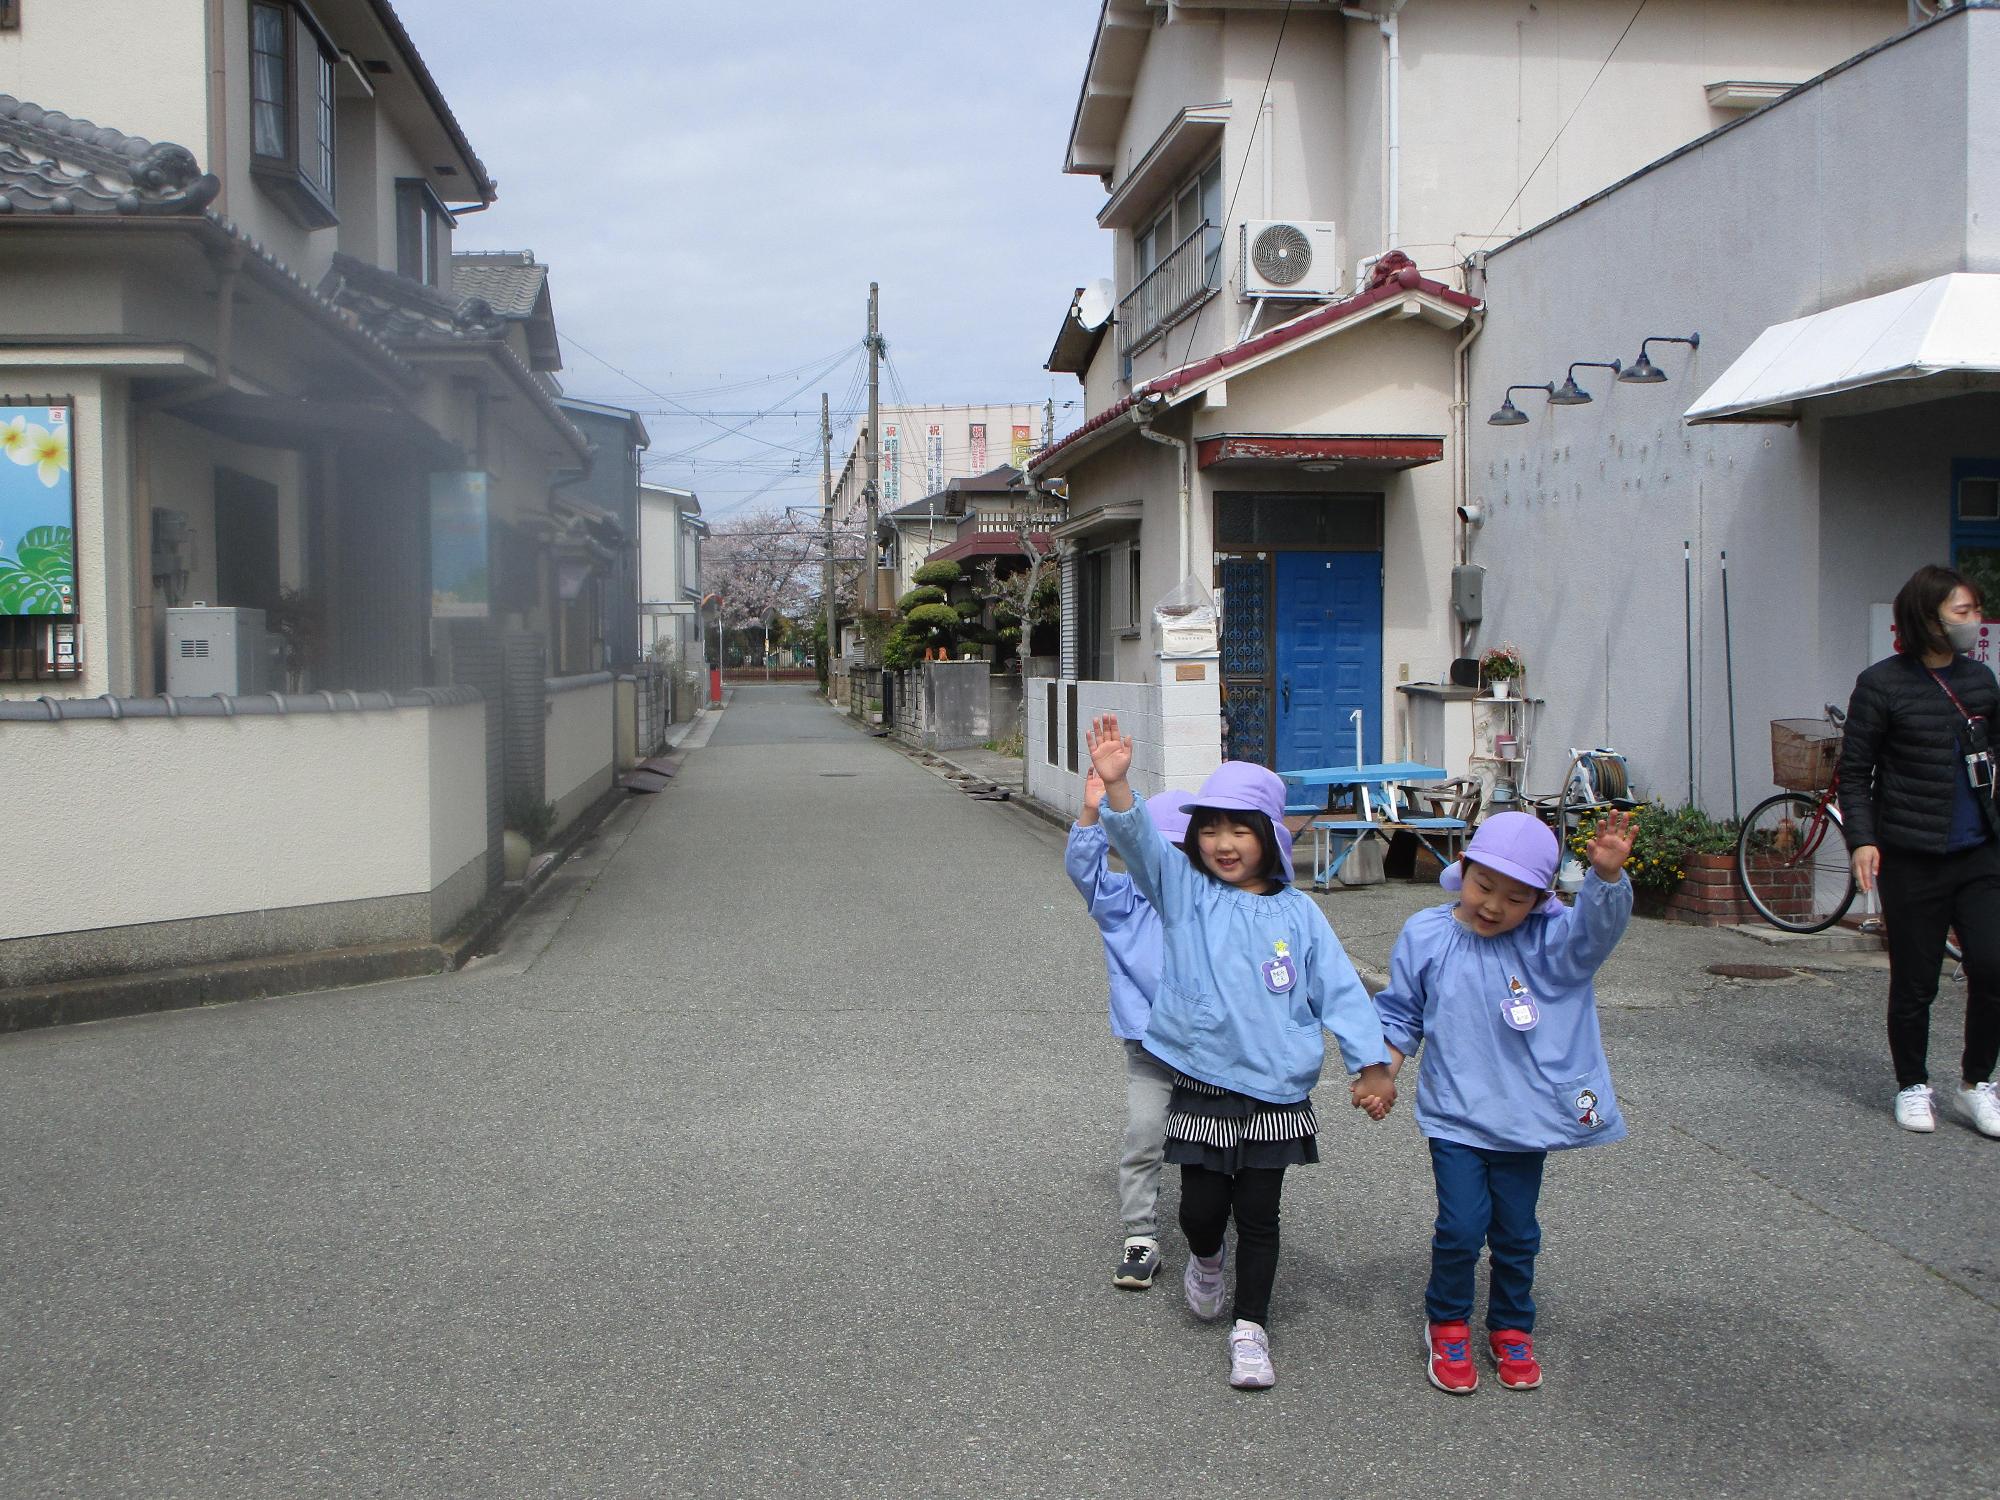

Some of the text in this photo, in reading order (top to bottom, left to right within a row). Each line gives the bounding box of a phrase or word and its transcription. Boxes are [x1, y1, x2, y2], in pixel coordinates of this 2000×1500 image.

[886, 426, 896, 436] 祝
[929, 425, 939, 436] 祝
[972, 425, 984, 437] 祝
